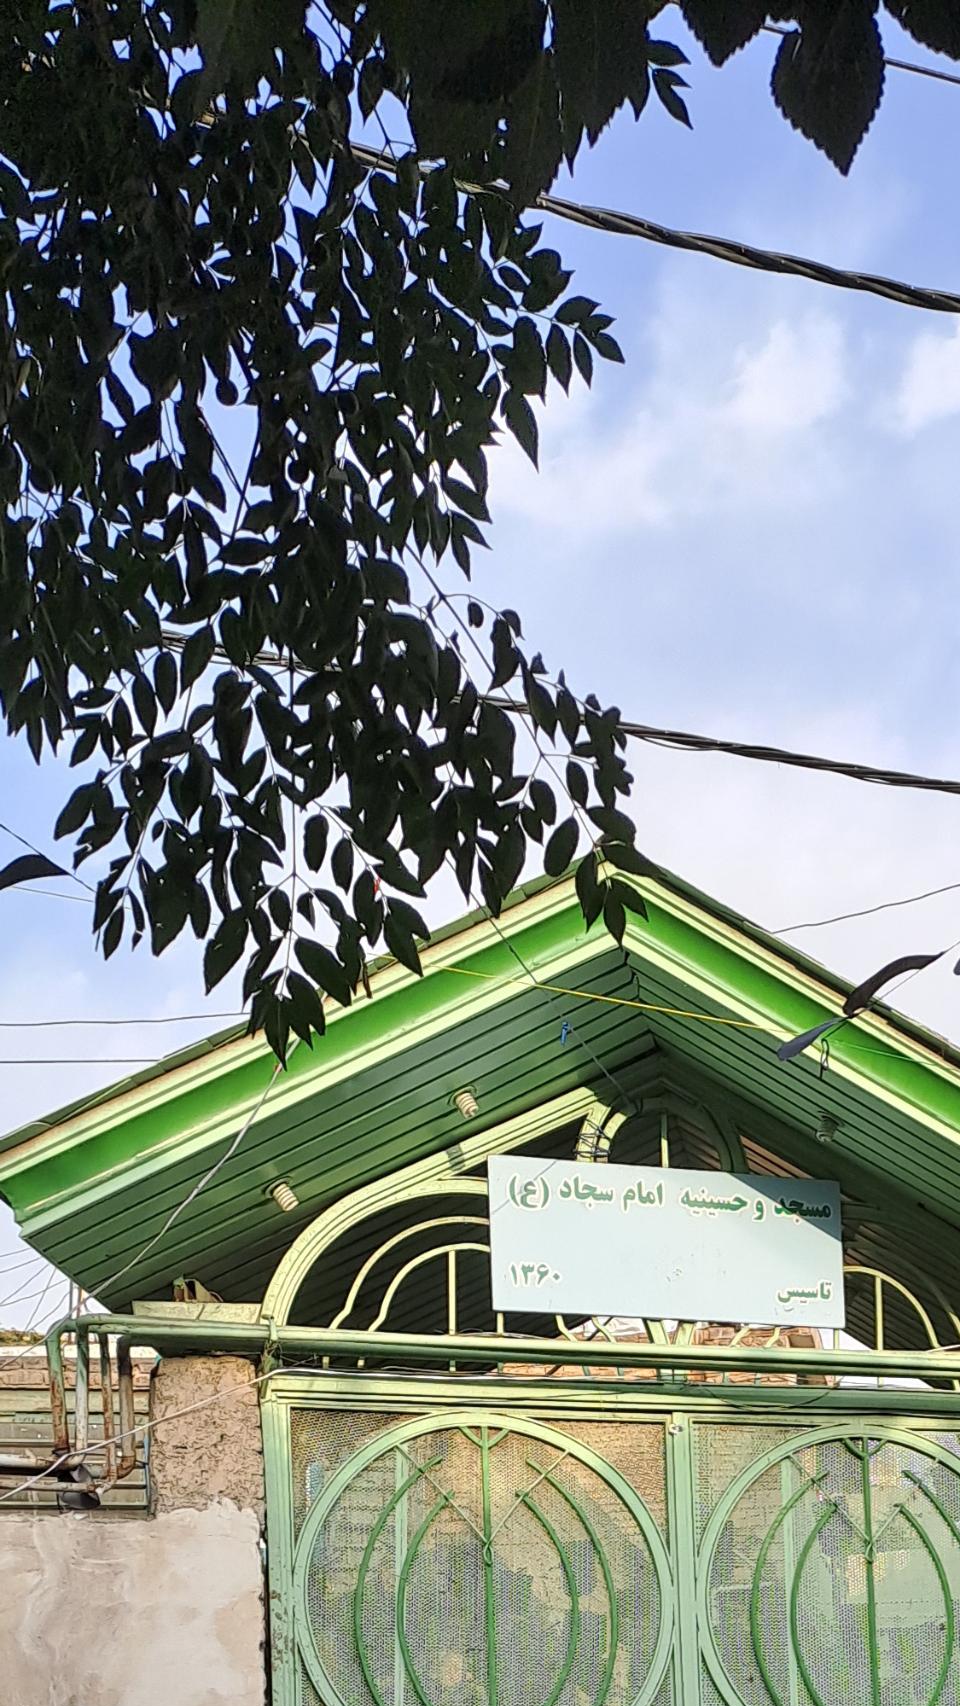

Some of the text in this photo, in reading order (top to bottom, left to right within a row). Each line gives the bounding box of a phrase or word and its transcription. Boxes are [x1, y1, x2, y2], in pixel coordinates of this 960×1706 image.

[559, 1175, 614, 1208] سجاد
[622, 1182, 664, 1211] امام
[680, 1187, 748, 1217] حسینیه
[753, 1199, 765, 1221] و
[774, 1194, 832, 1223] مسجد
[509, 1262, 833, 1304] تاسیس ۱۳۶۰
